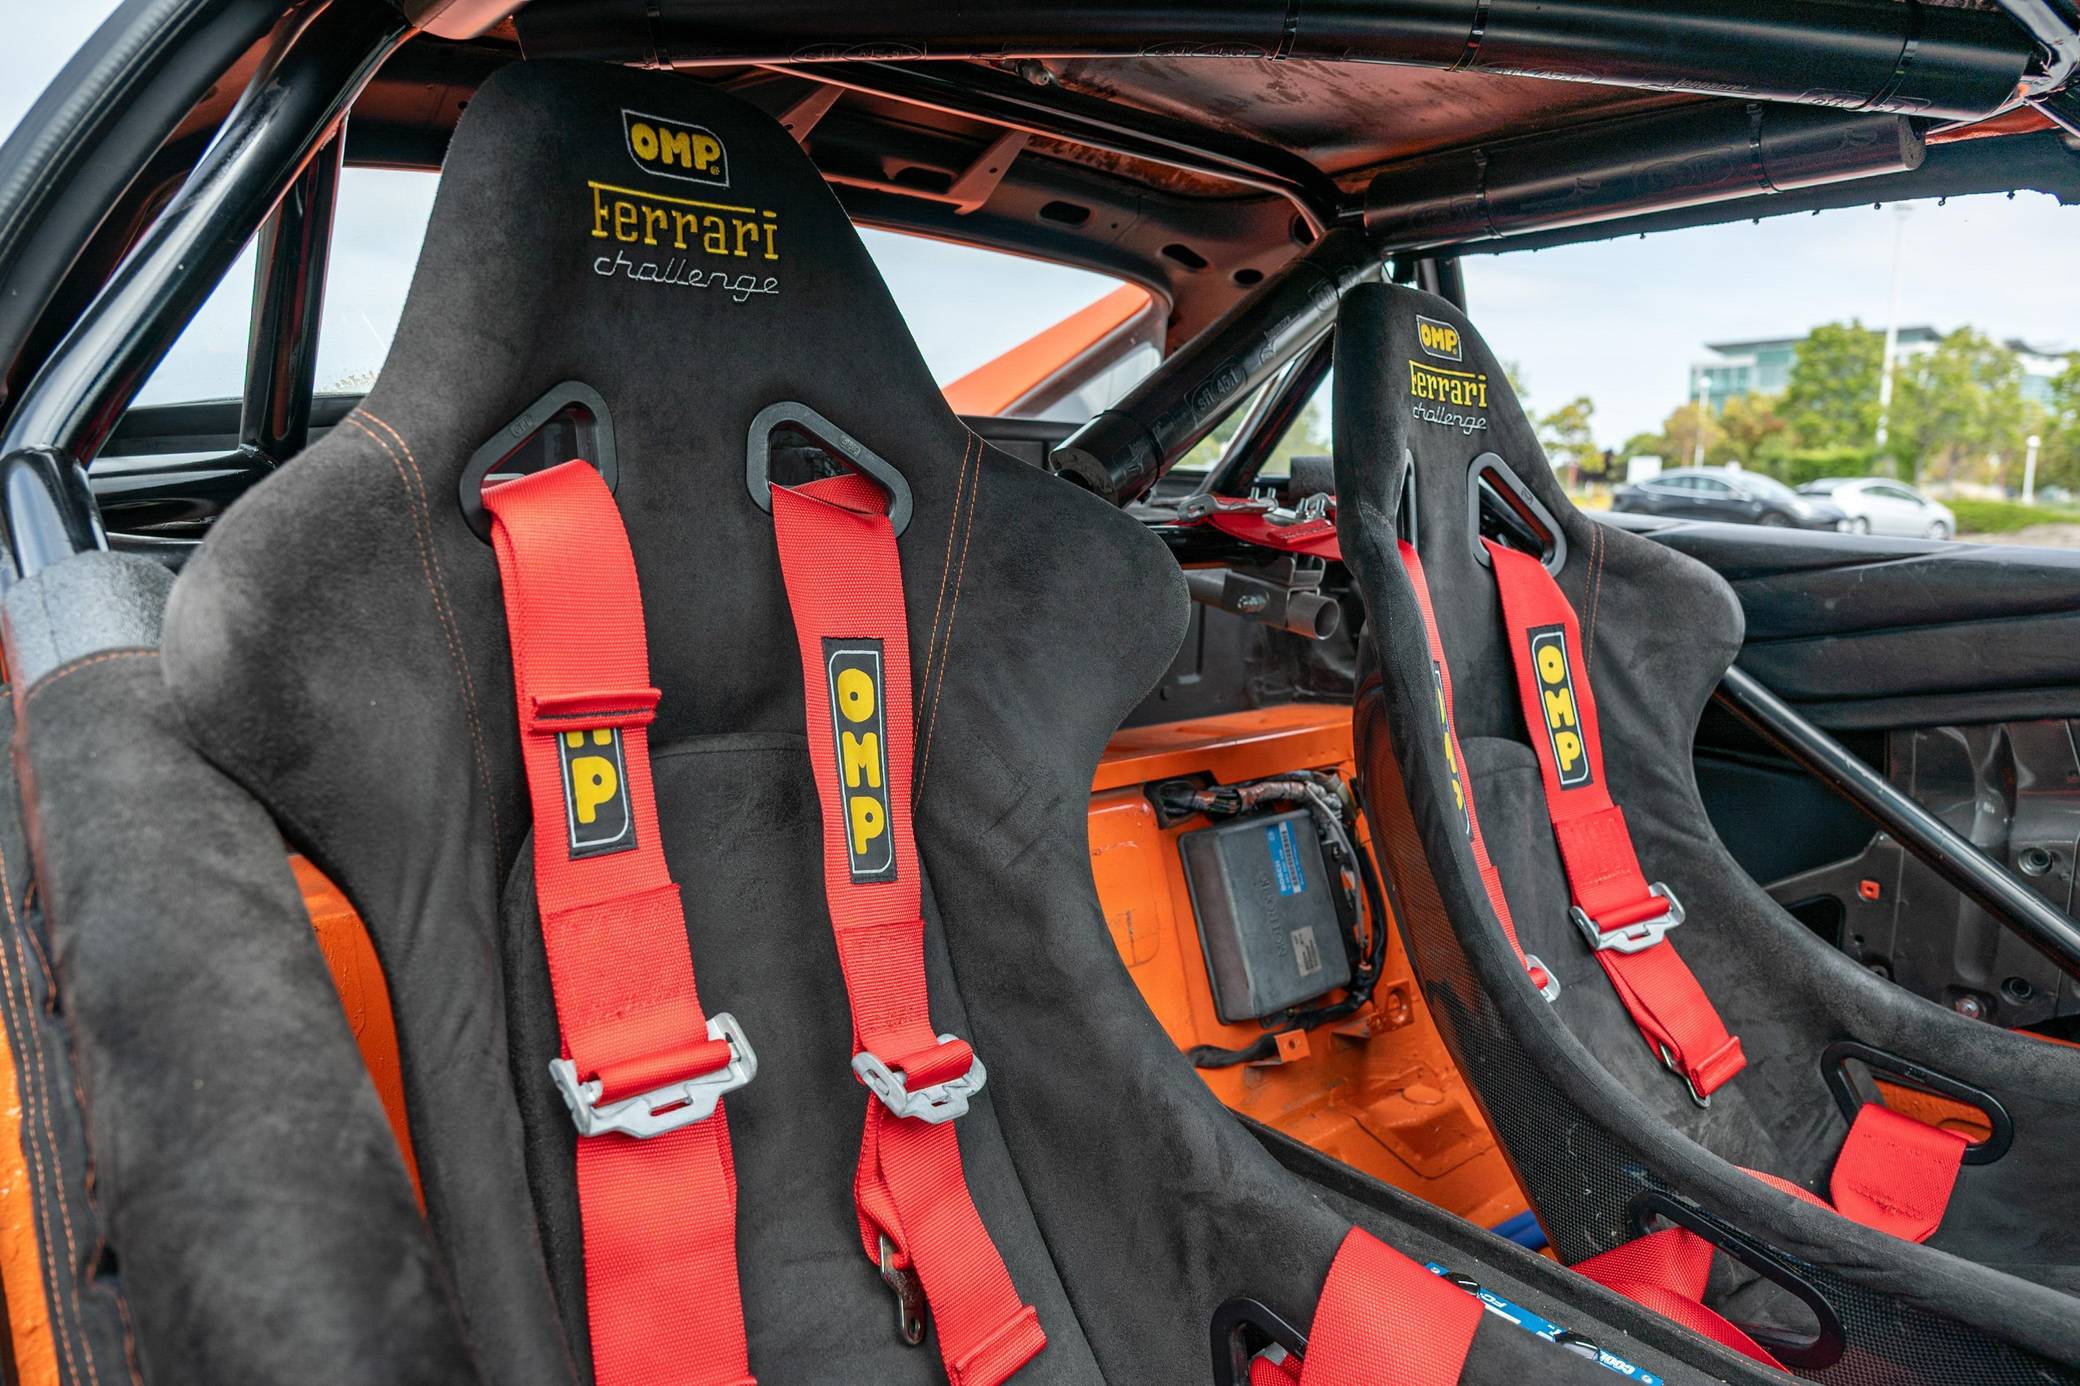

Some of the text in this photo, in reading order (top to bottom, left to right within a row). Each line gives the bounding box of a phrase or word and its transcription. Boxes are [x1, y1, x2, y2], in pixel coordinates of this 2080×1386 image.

[631, 122, 720, 172] OMP
[588, 180, 779, 260] Ferrari
[594, 250, 779, 301] challenge
[1420, 323, 1458, 354] OMP
[1408, 360, 1487, 408] Ferrari
[1412, 402, 1487, 435] challenge
[1537, 645, 1581, 773] OMP
[837, 668, 885, 855] OMP
